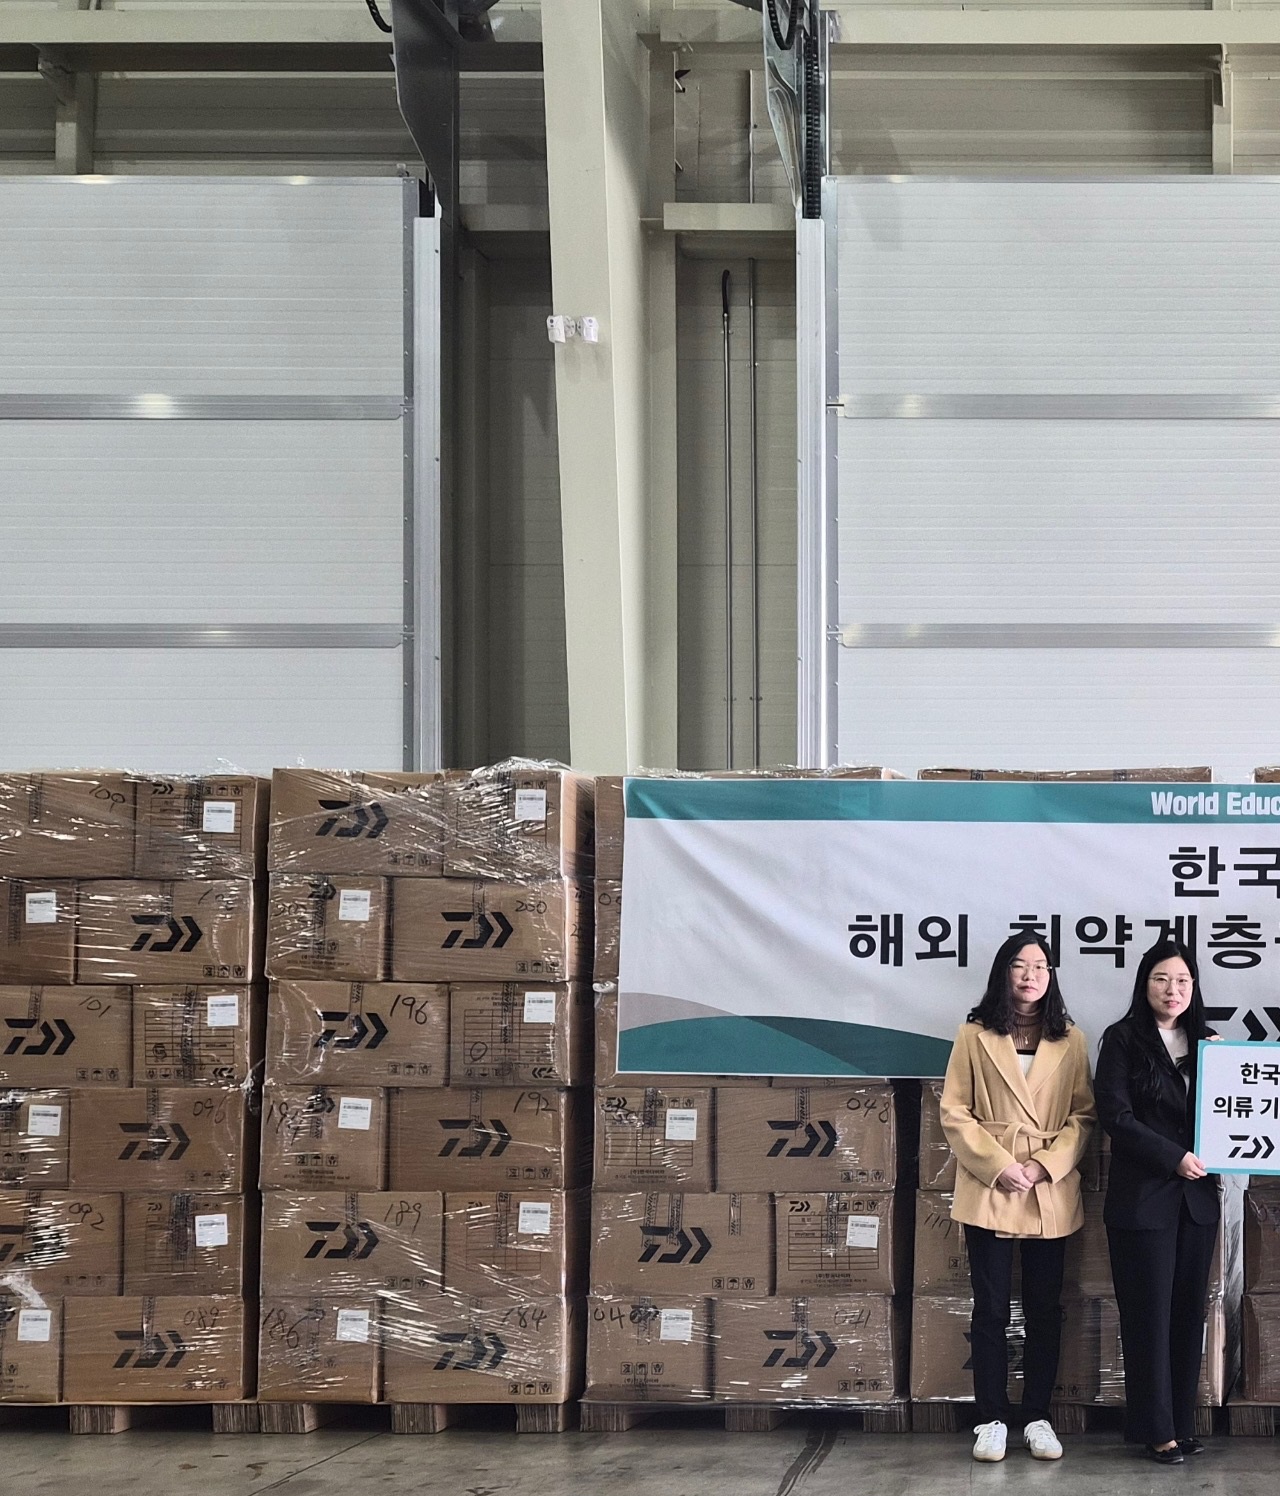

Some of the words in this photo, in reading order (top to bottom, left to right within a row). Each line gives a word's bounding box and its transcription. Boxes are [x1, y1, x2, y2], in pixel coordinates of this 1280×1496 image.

[1151, 791, 1219, 816] World
[514, 900, 548, 915] 200
[847, 912, 969, 968] 해외
[389, 994, 430, 1025] 196
[512, 1092, 558, 1116] 192
[846, 1097, 890, 1123] 048
[1213, 1095, 1254, 1119] 의류
